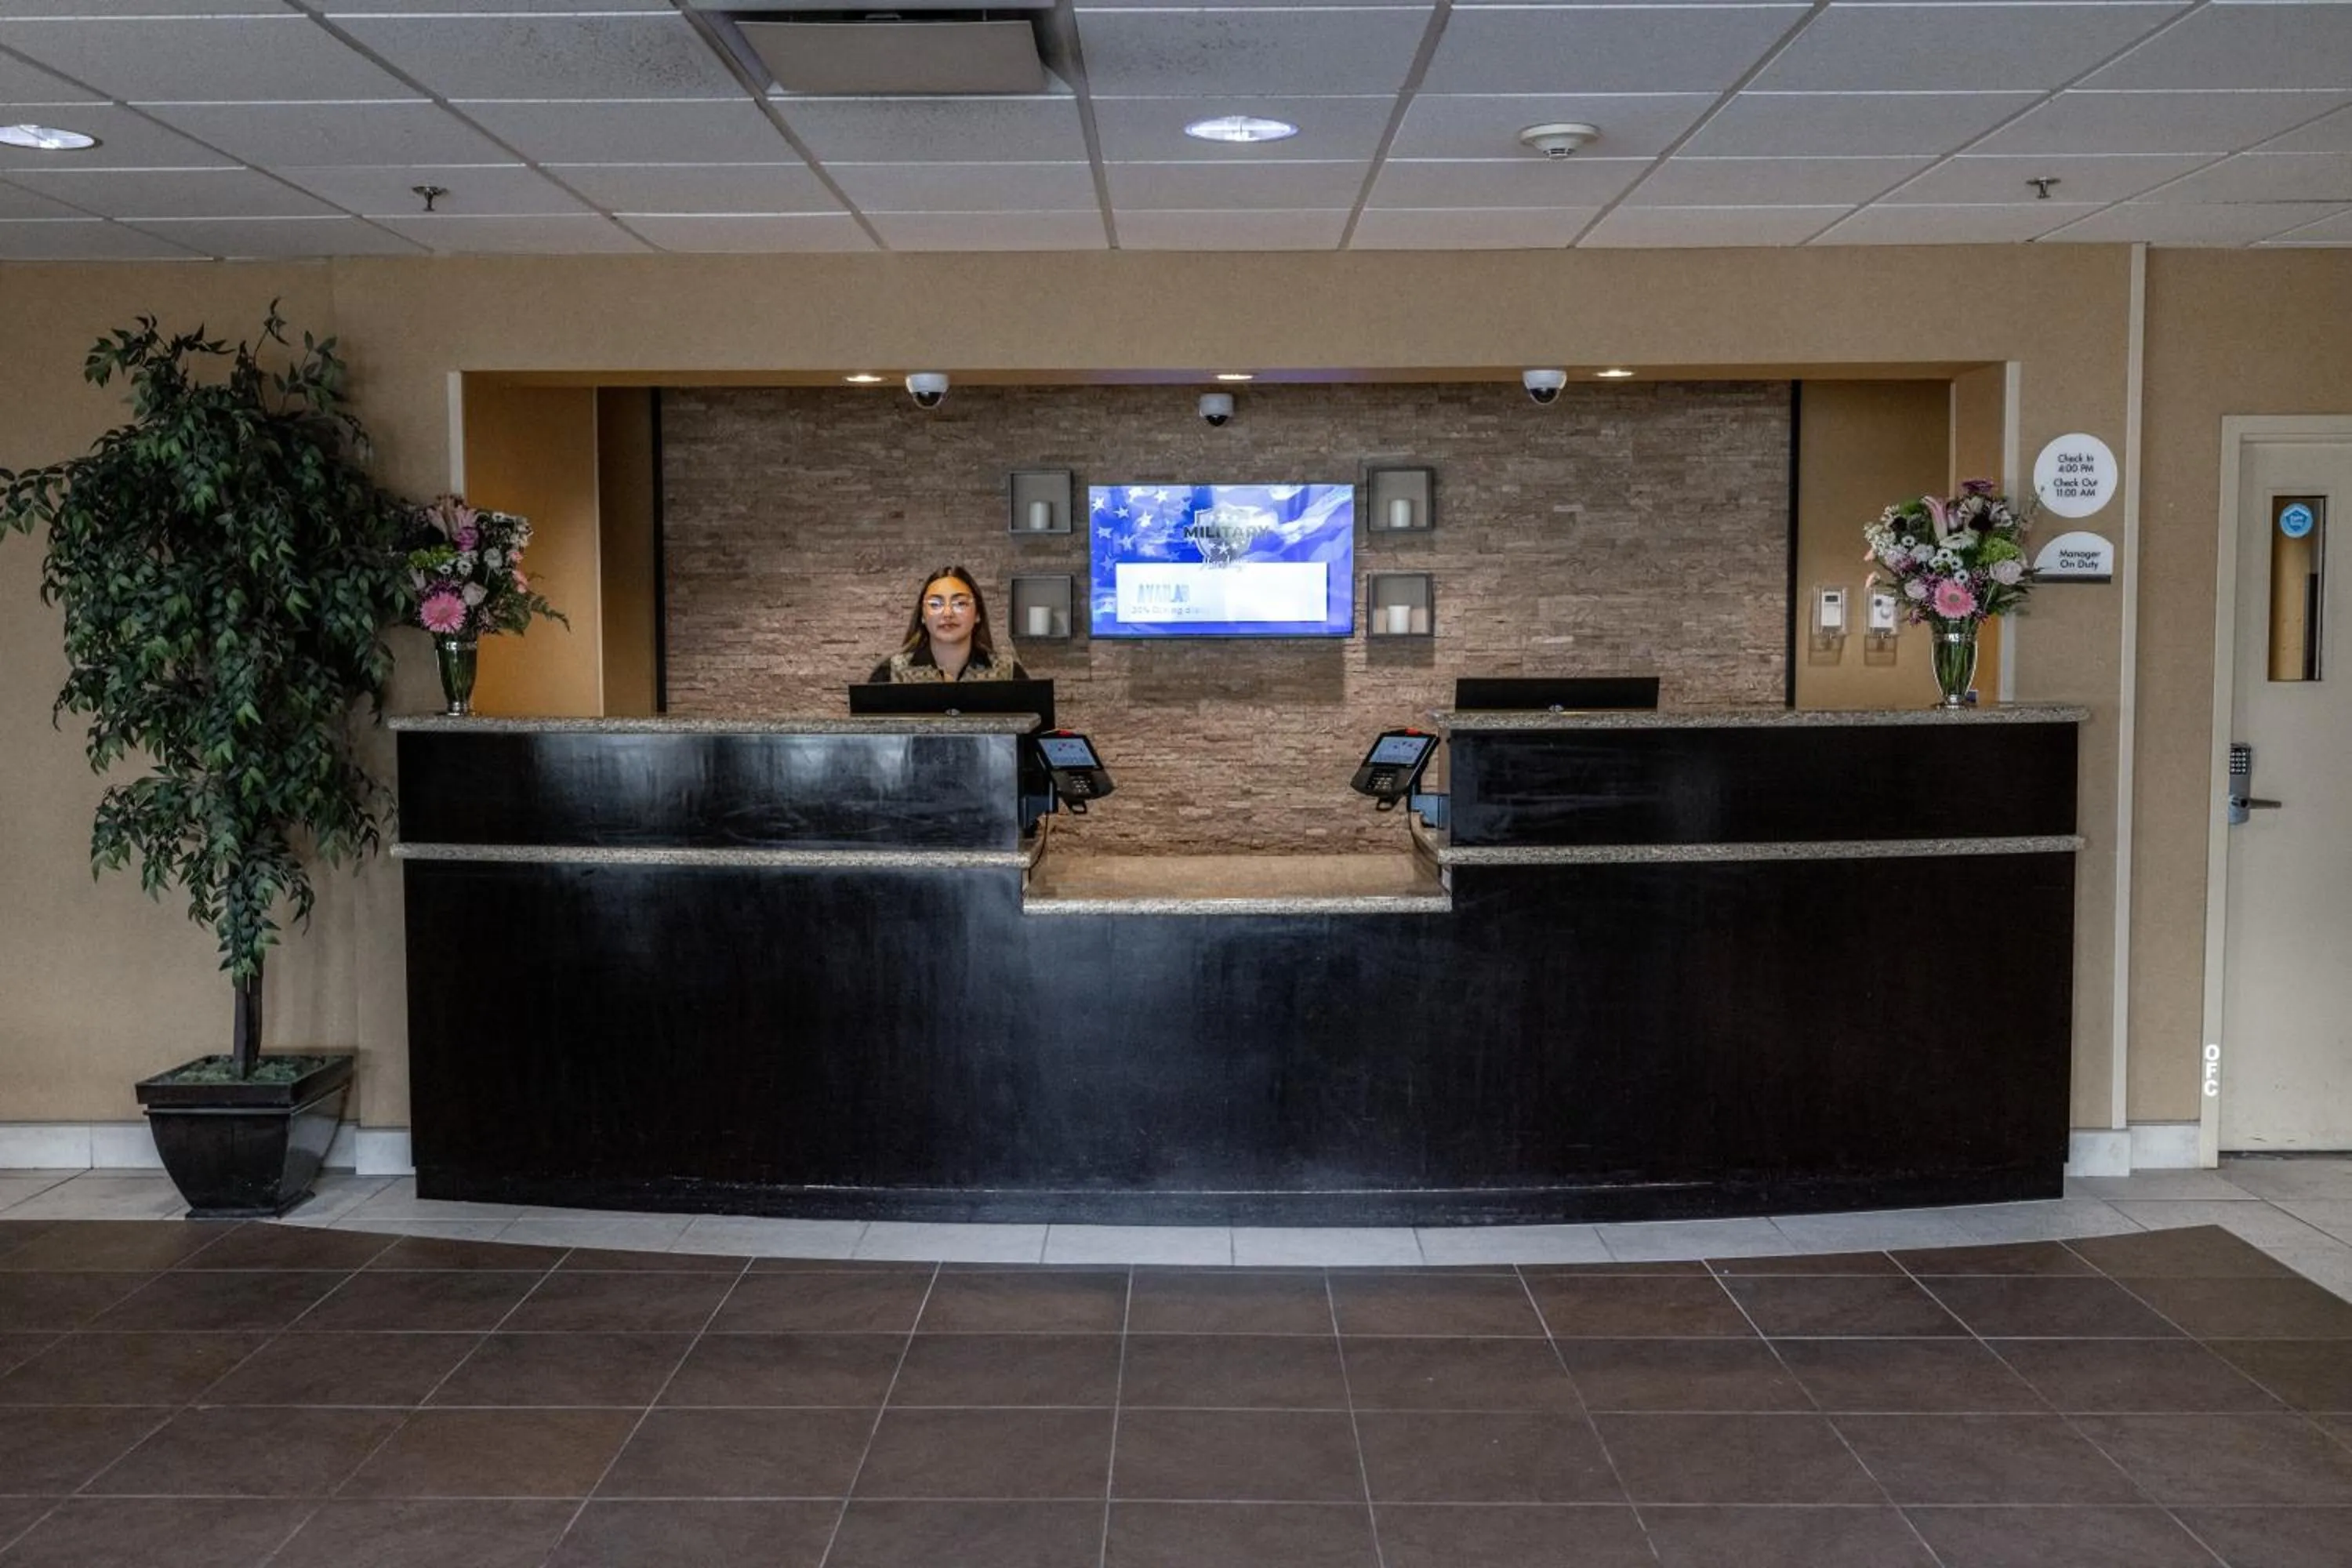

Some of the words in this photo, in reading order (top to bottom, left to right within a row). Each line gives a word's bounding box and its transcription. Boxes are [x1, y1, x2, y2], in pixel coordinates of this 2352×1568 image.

[2056, 453, 2082, 463] Check
[2086, 453, 2094, 463] In
[2058, 463, 2078, 473] 4:00
[2080, 463, 2094, 473] PM
[2053, 477, 2078, 487] Check
[2082, 478, 2098, 487] Out
[2056, 488, 2077, 497] 11:00
[1184, 525, 1270, 539] MILITARY
[2059, 549, 2101, 561] Manager
[2060, 559, 2075, 568] On
[2078, 559, 2100, 571] Duty
[2204, 1044, 2220, 1097] OFC
